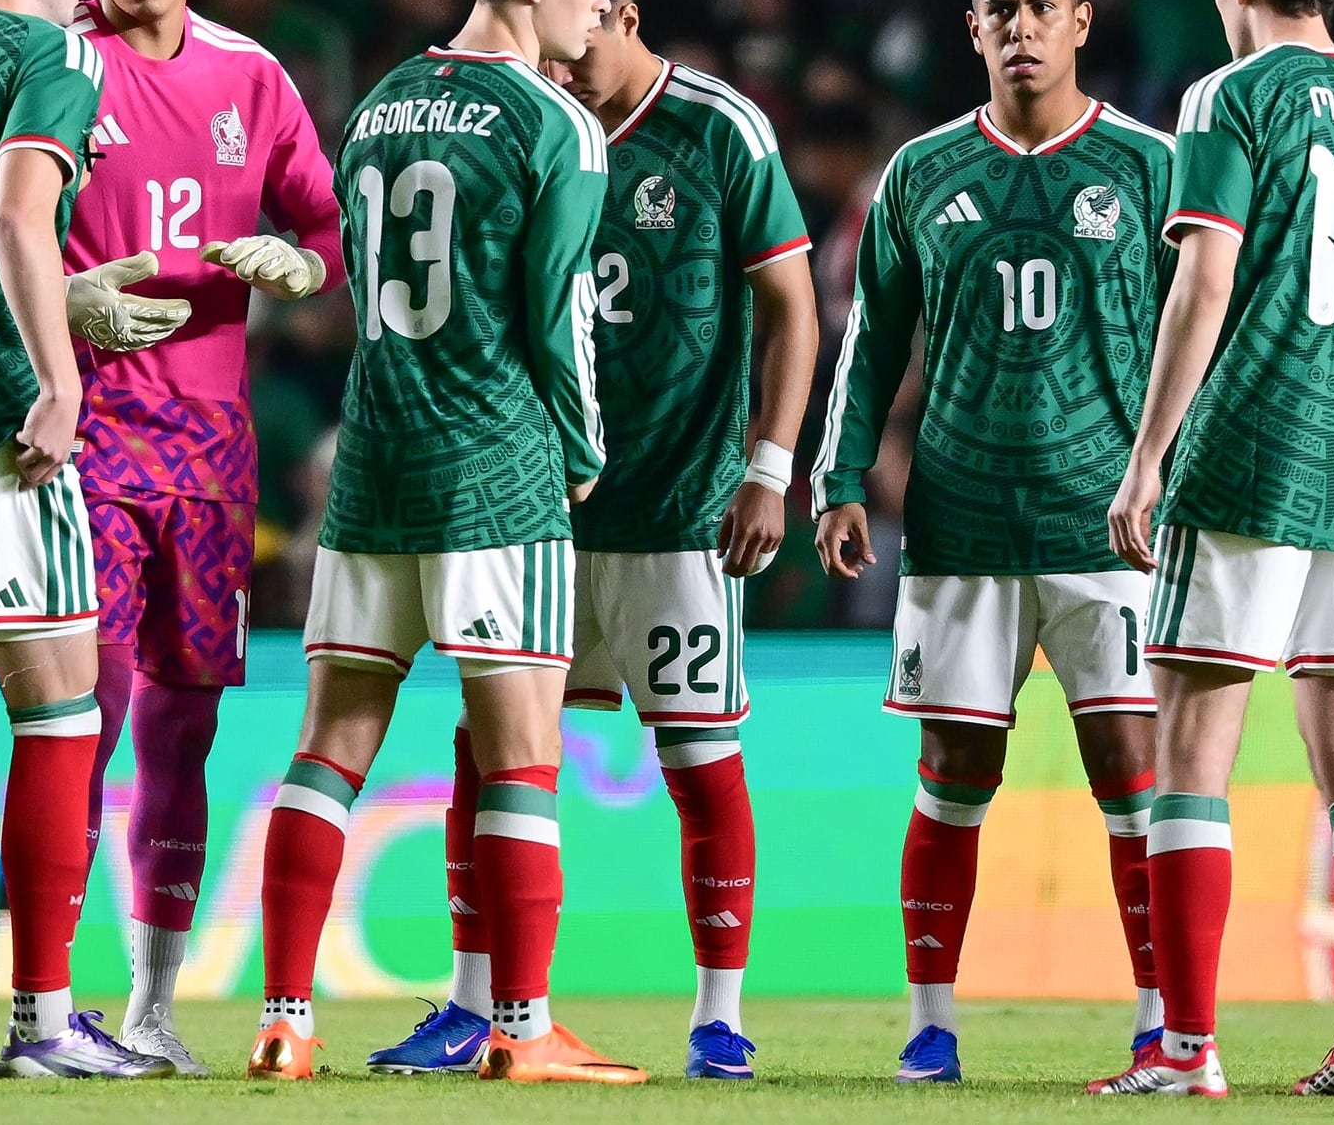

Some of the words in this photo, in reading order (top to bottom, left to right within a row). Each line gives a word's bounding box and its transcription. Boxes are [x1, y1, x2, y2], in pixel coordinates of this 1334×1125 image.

[352, 91, 501, 143] A.GONZÁLEZ
[147, 177, 203, 252] 12
[359, 160, 457, 341] 13
[597, 252, 634, 324] 2
[996, 258, 1057, 333] 10
[648, 624, 721, 695] 22
[1119, 605, 1147, 677] 1
